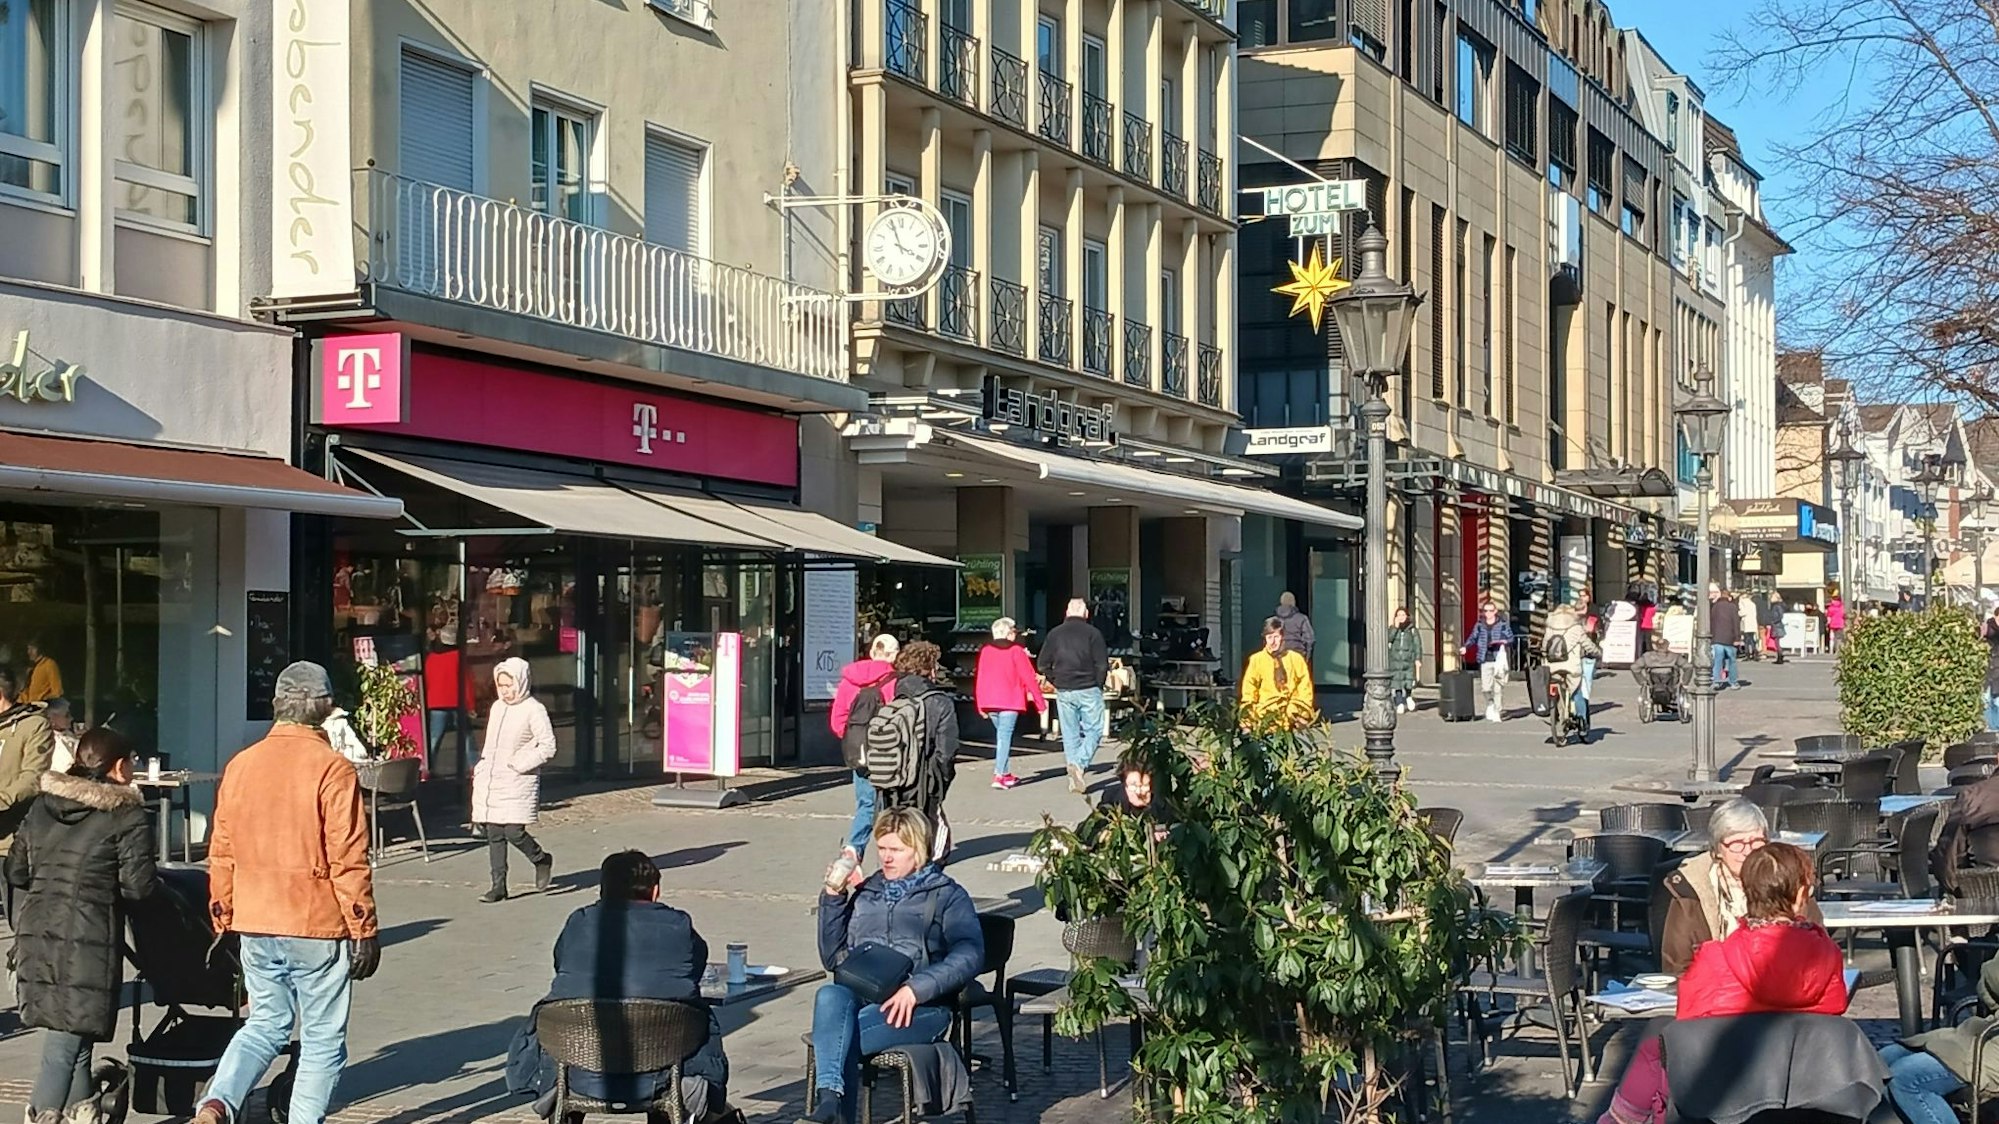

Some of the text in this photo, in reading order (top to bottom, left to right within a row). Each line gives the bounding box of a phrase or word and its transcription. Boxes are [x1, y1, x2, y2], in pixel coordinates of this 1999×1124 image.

[1266, 183, 1358, 215] HOTEL
[1292, 213, 1335, 234] ZUM
[337, 347, 381, 409] T
[991, 374, 1113, 448] Landgraf
[1249, 432, 1326, 448] Landgraf
